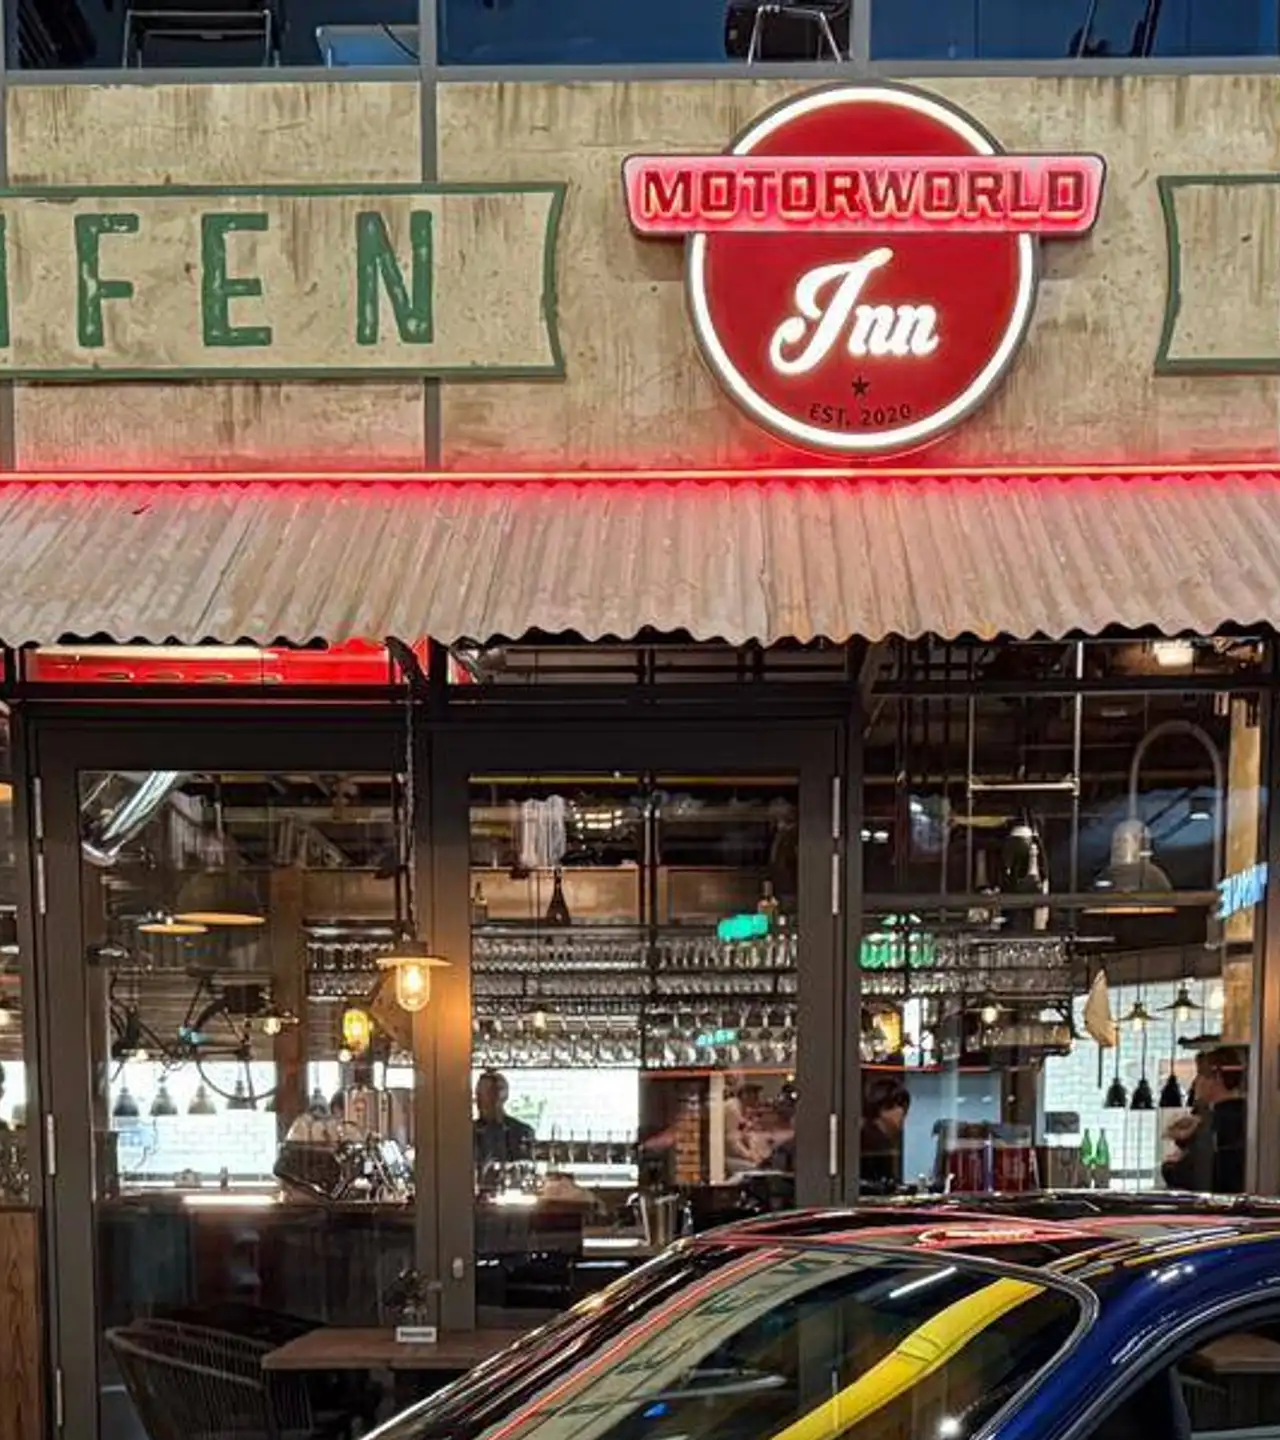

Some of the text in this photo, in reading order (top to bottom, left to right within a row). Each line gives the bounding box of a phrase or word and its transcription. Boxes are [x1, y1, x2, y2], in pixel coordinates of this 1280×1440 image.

[644, 167, 1085, 219] MOTORWORLD
[768, 247, 941, 376] Inn
[809, 402, 912, 428] EST. 2020
